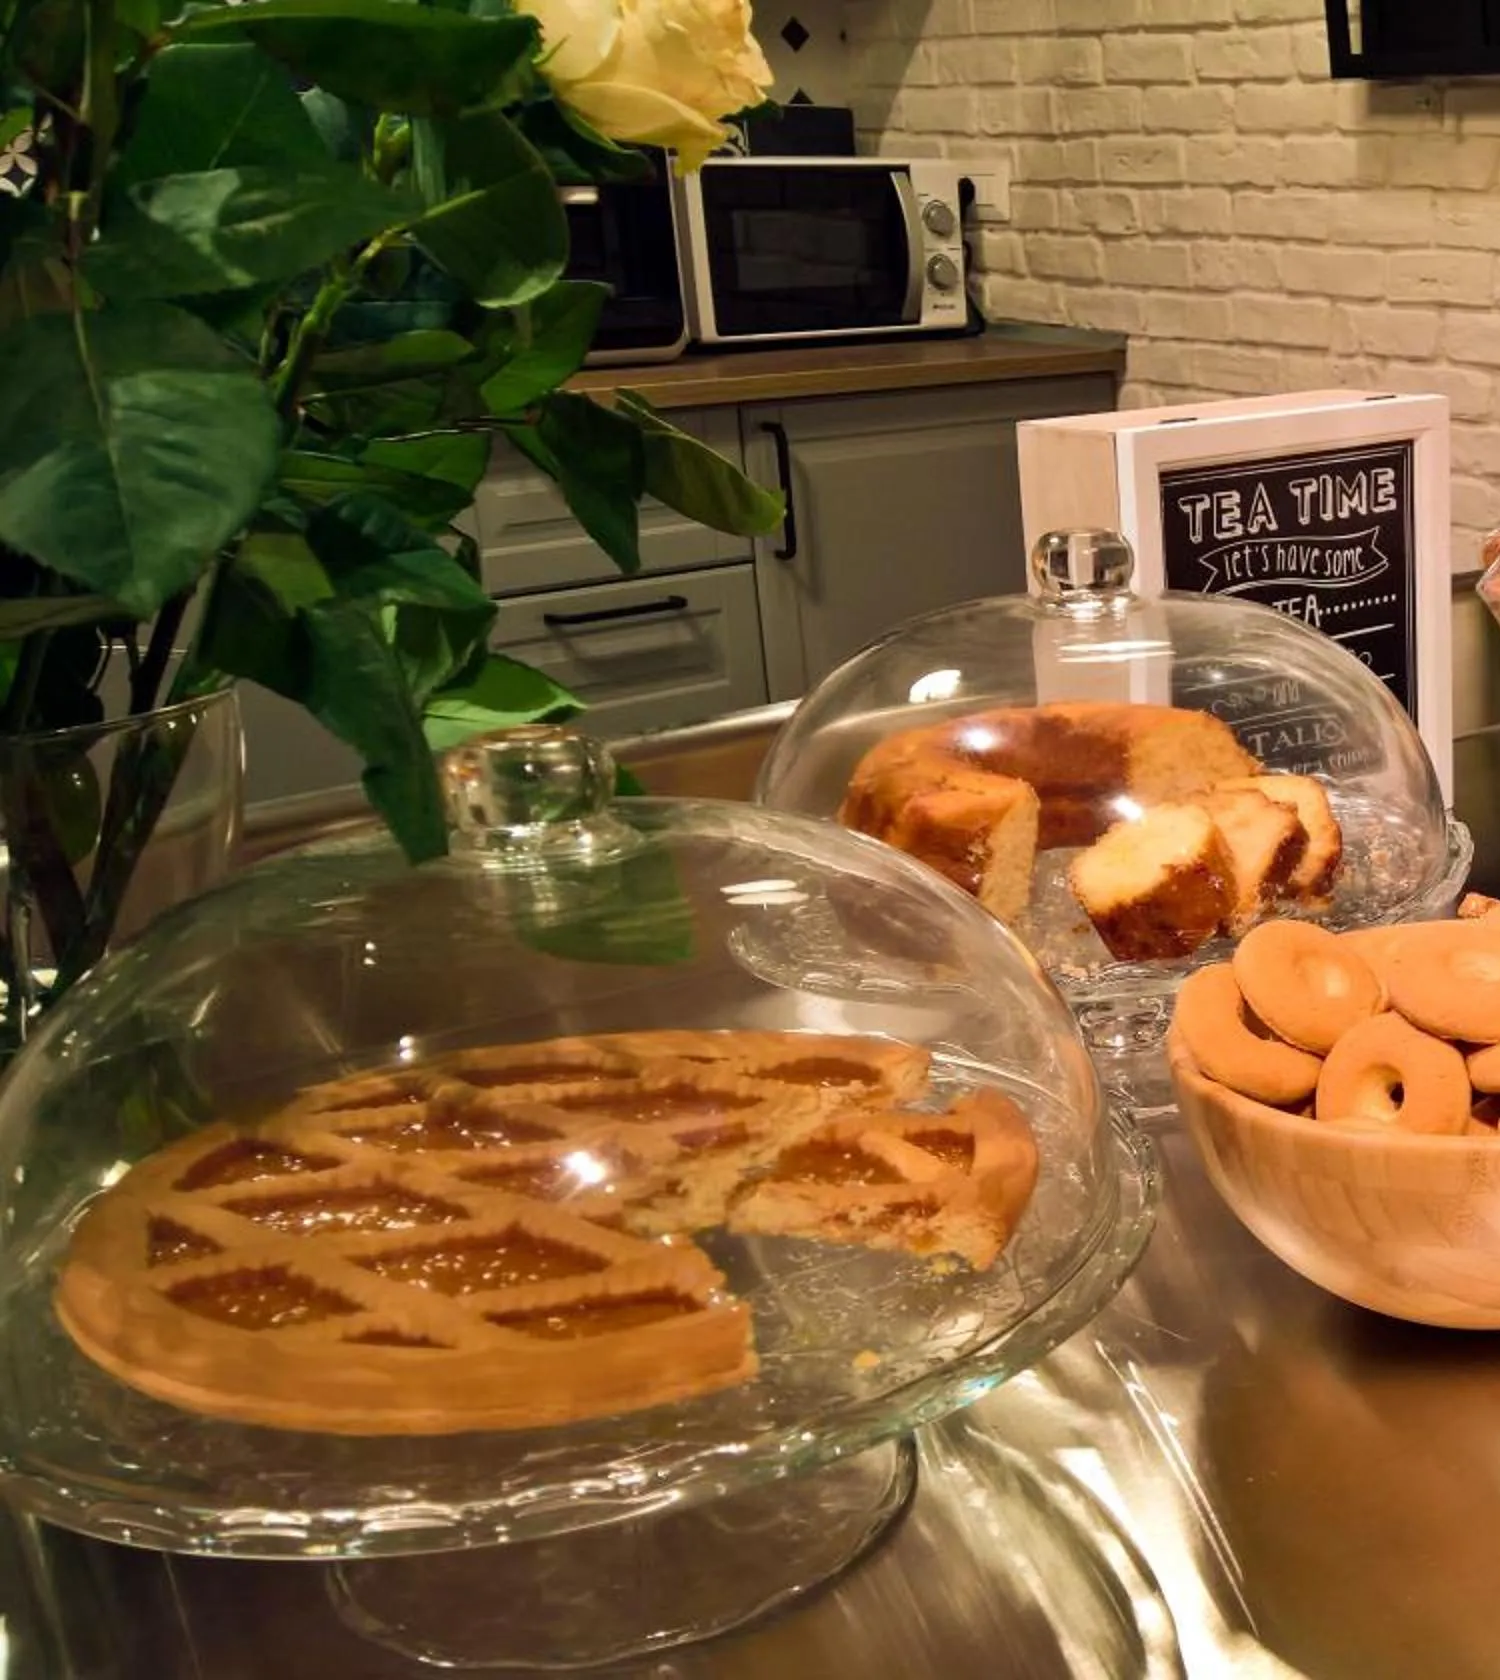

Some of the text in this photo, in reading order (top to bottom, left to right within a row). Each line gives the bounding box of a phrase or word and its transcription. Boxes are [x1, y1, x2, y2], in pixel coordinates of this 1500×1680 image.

[1177, 467, 1397, 544] TEA TIME
[1223, 543, 1366, 581] let's have some
